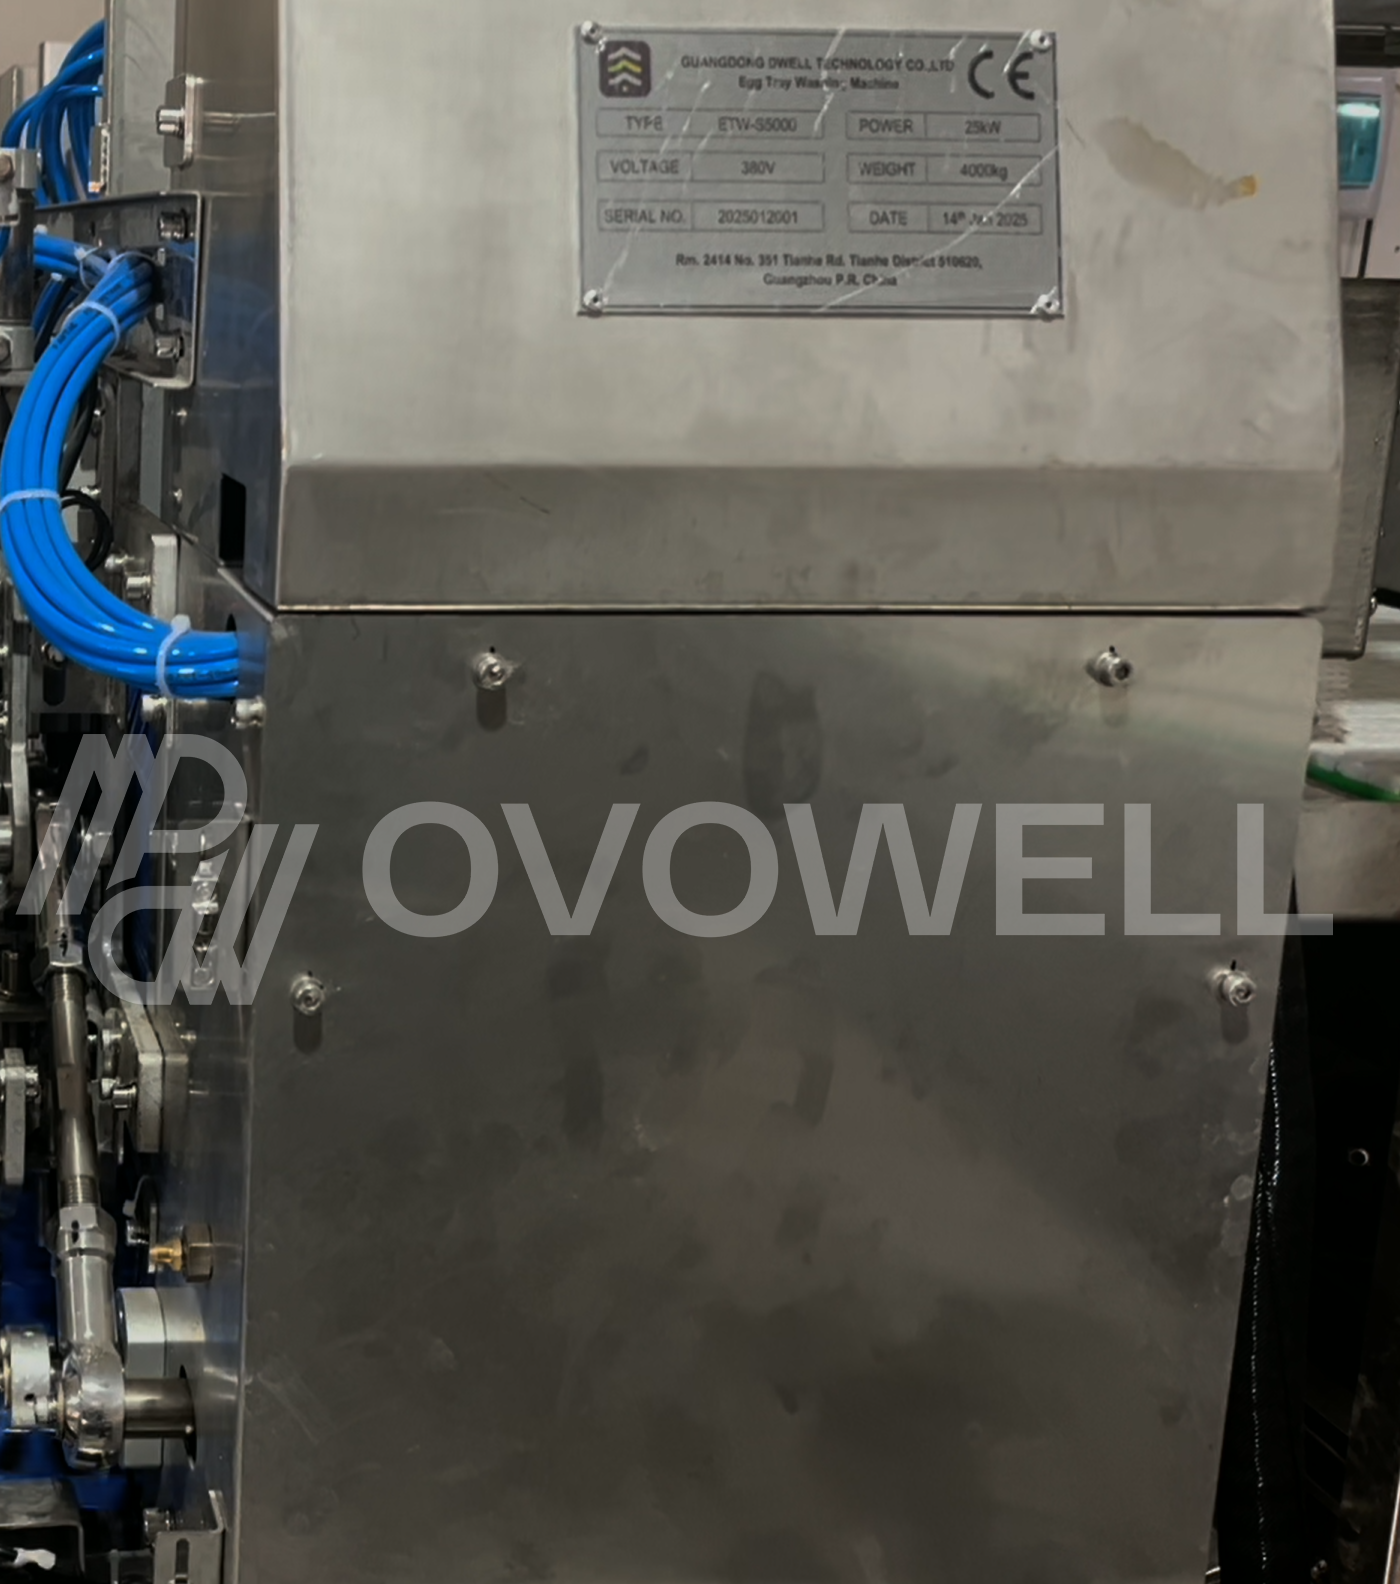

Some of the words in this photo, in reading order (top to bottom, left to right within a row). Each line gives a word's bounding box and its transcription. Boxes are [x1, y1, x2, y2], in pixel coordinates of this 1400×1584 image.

[738, 75, 762, 91] Egg
[718, 116, 798, 133] ETW-S5000
[859, 118, 914, 134] POWER
[965, 120, 1001, 135] 25kW
[610, 159, 680, 175] VOLTAGE
[741, 161, 775, 175] 380V
[859, 162, 916, 177] WEIGHT
[960, 164, 1009, 182] 4000kg
[604, 209, 656, 225] SERIAL
[660, 209, 686, 225] NO.
[718, 210, 799, 225] 2025012001
[869, 211, 908, 226] DATE
[996, 213, 1029, 228] 2025
[675, 253, 700, 267] Rm.
[703, 253, 731, 267] 2414
[734, 253, 755, 267] No.
[758, 253, 778, 267] 351
[783, 253, 823, 268] Tianhe
[826, 253, 846, 268] Rd.
[849, 254, 890, 268] Tianhe
[763, 273, 833, 289] Guangzhou
[835, 273, 861, 287] P.R.
